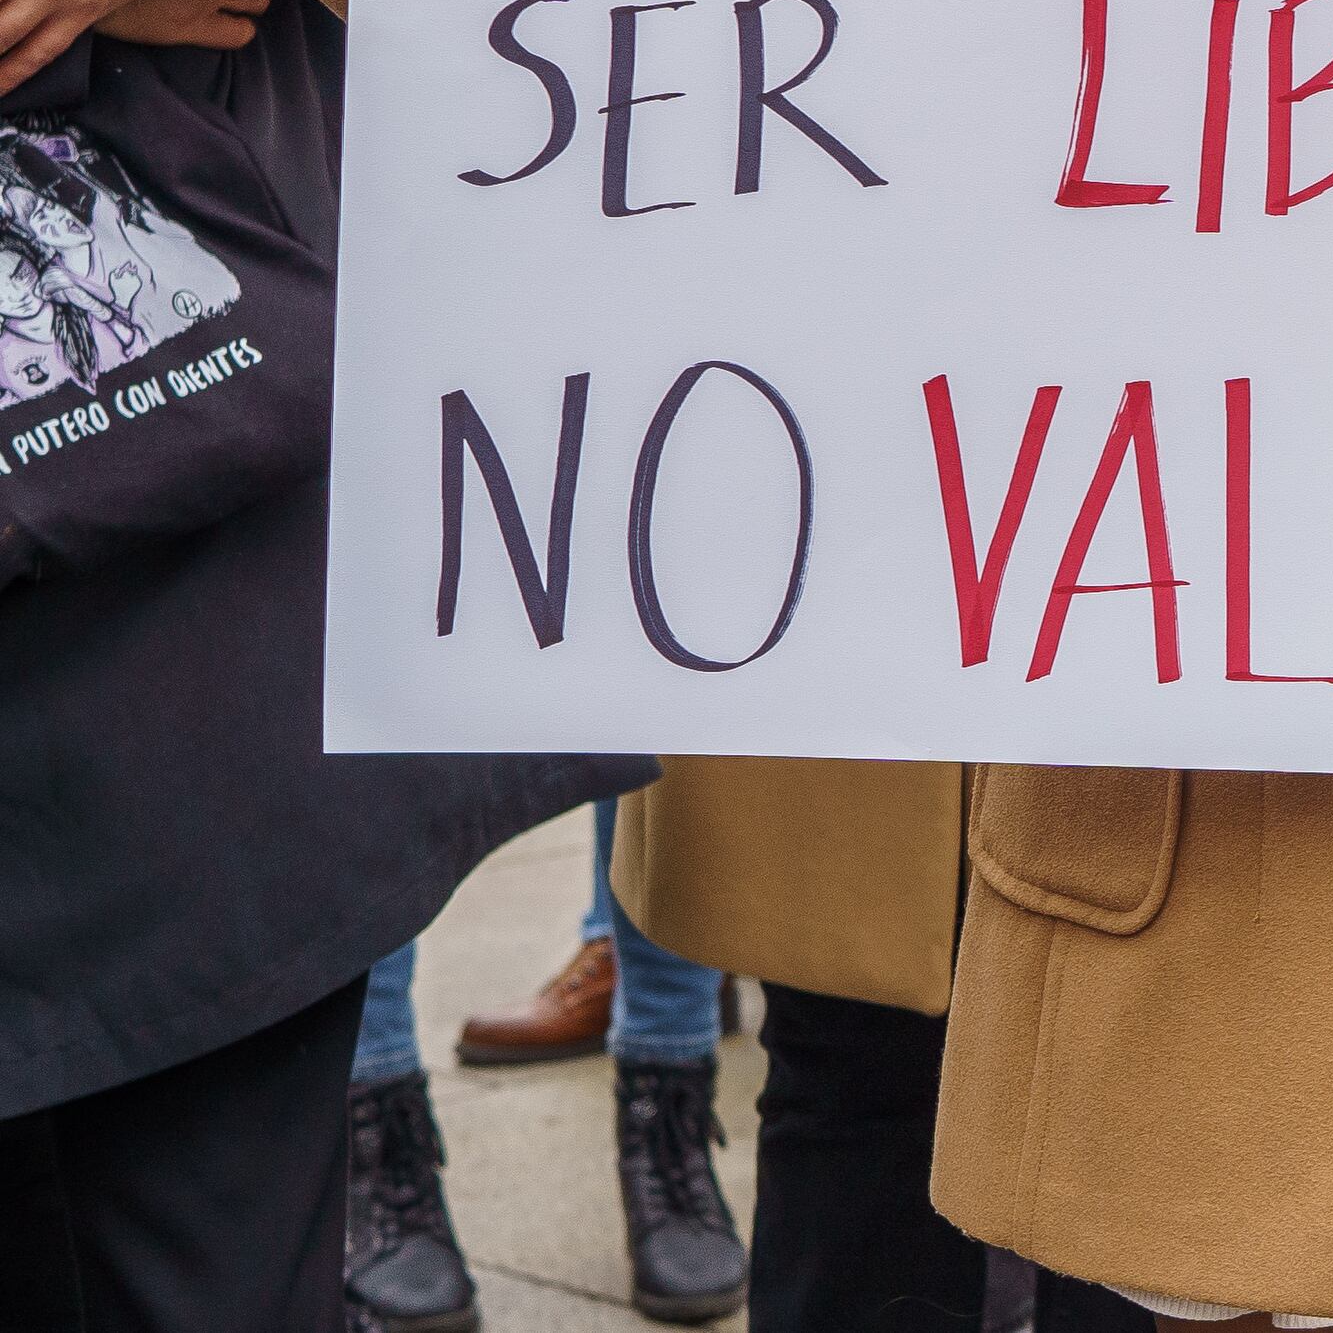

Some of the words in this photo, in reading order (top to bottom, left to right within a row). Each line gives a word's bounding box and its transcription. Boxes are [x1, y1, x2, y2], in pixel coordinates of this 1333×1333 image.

[12, 401, 110, 465] PUTERO
[114, 377, 167, 419] CON
[437, 361, 813, 672] NO
